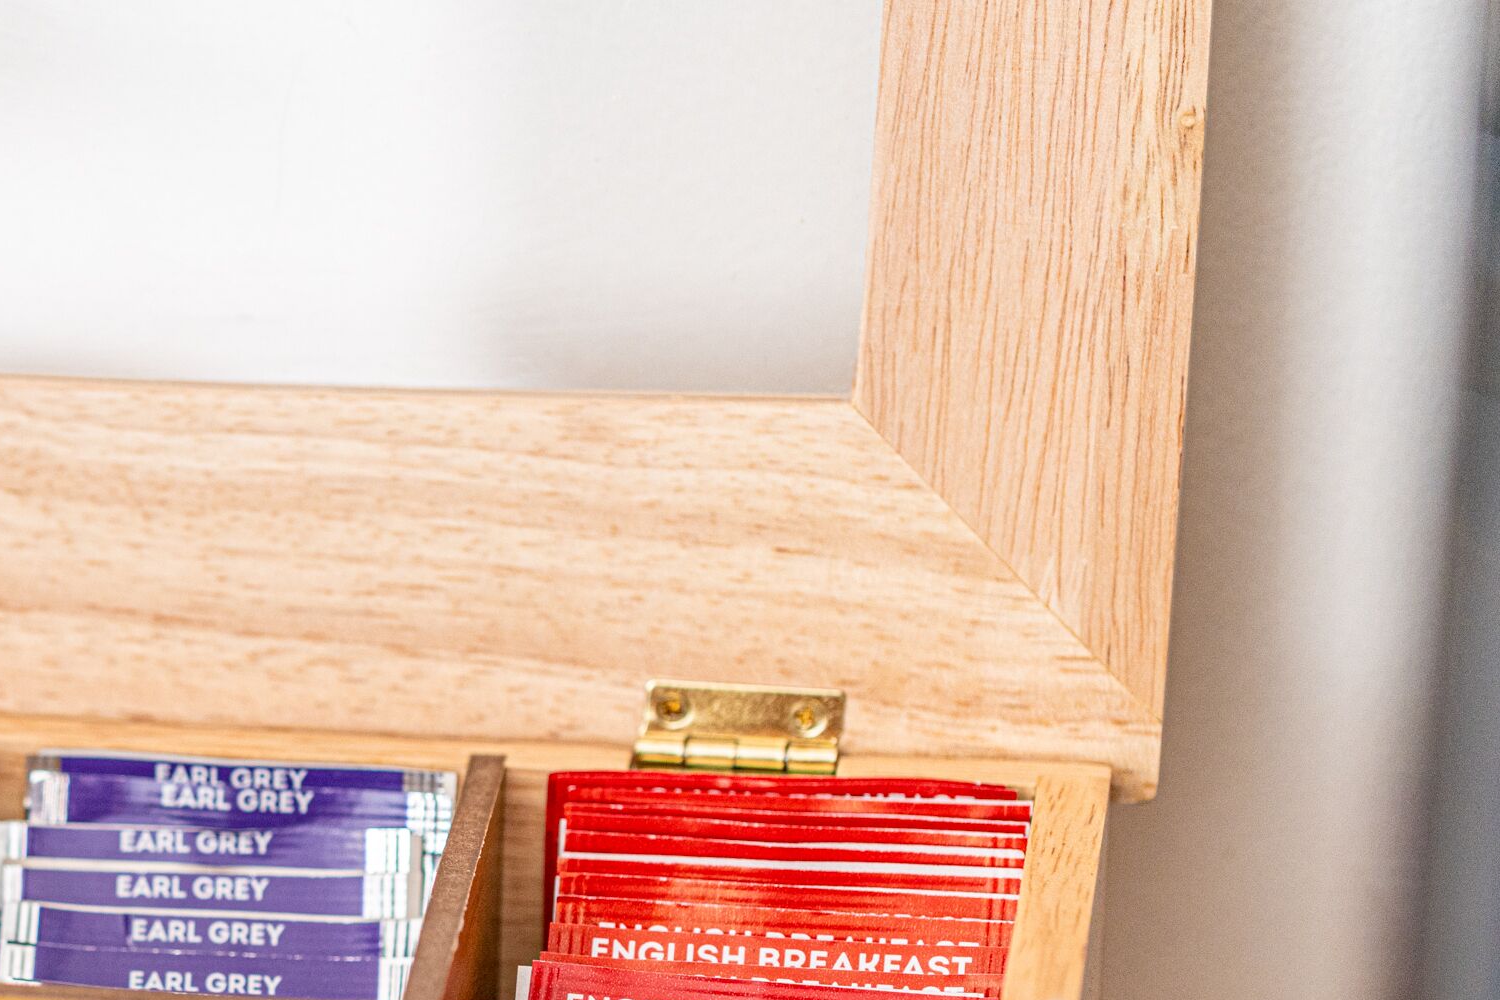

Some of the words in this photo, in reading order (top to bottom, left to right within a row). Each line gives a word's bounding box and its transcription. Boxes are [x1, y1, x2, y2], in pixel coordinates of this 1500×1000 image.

[154, 763, 224, 787] EARL
[230, 768, 308, 791] GREY
[160, 784, 232, 811] EARL
[237, 788, 315, 815] GREY
[119, 829, 191, 854] EARL
[196, 831, 273, 856] GREY
[115, 875, 187, 899] EARL
[192, 876, 270, 902] GREY
[130, 918, 202, 944] EARL
[208, 921, 285, 947] GREY
[590, 936, 745, 966] ENGLISH
[758, 946, 974, 977] BREAKFAST
[128, 970, 198, 993] EARL
[205, 972, 282, 996] GREY
